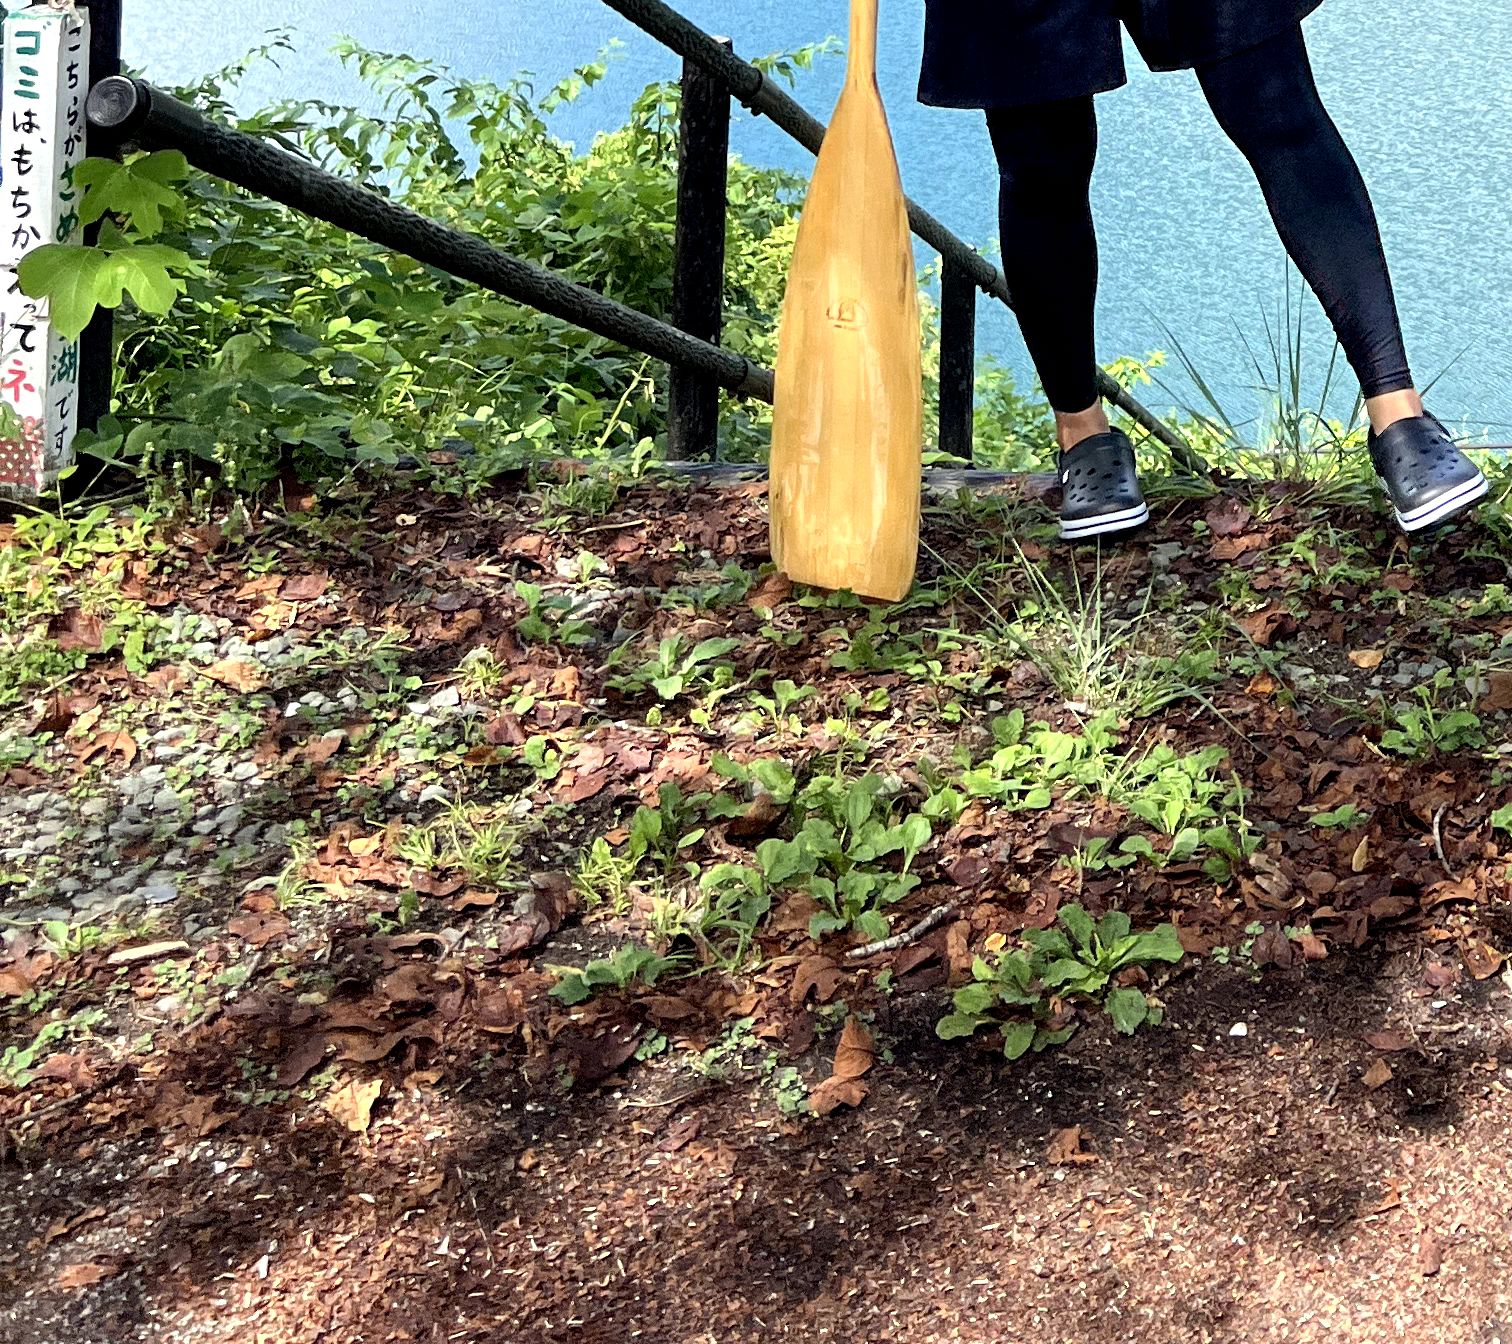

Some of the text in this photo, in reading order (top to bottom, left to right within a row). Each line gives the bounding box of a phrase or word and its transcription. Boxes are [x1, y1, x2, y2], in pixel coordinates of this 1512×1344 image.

[3, 21, 52, 403] ゴミは、もちかってネ
[50, 25, 82, 458] こちらがさめ湖です
